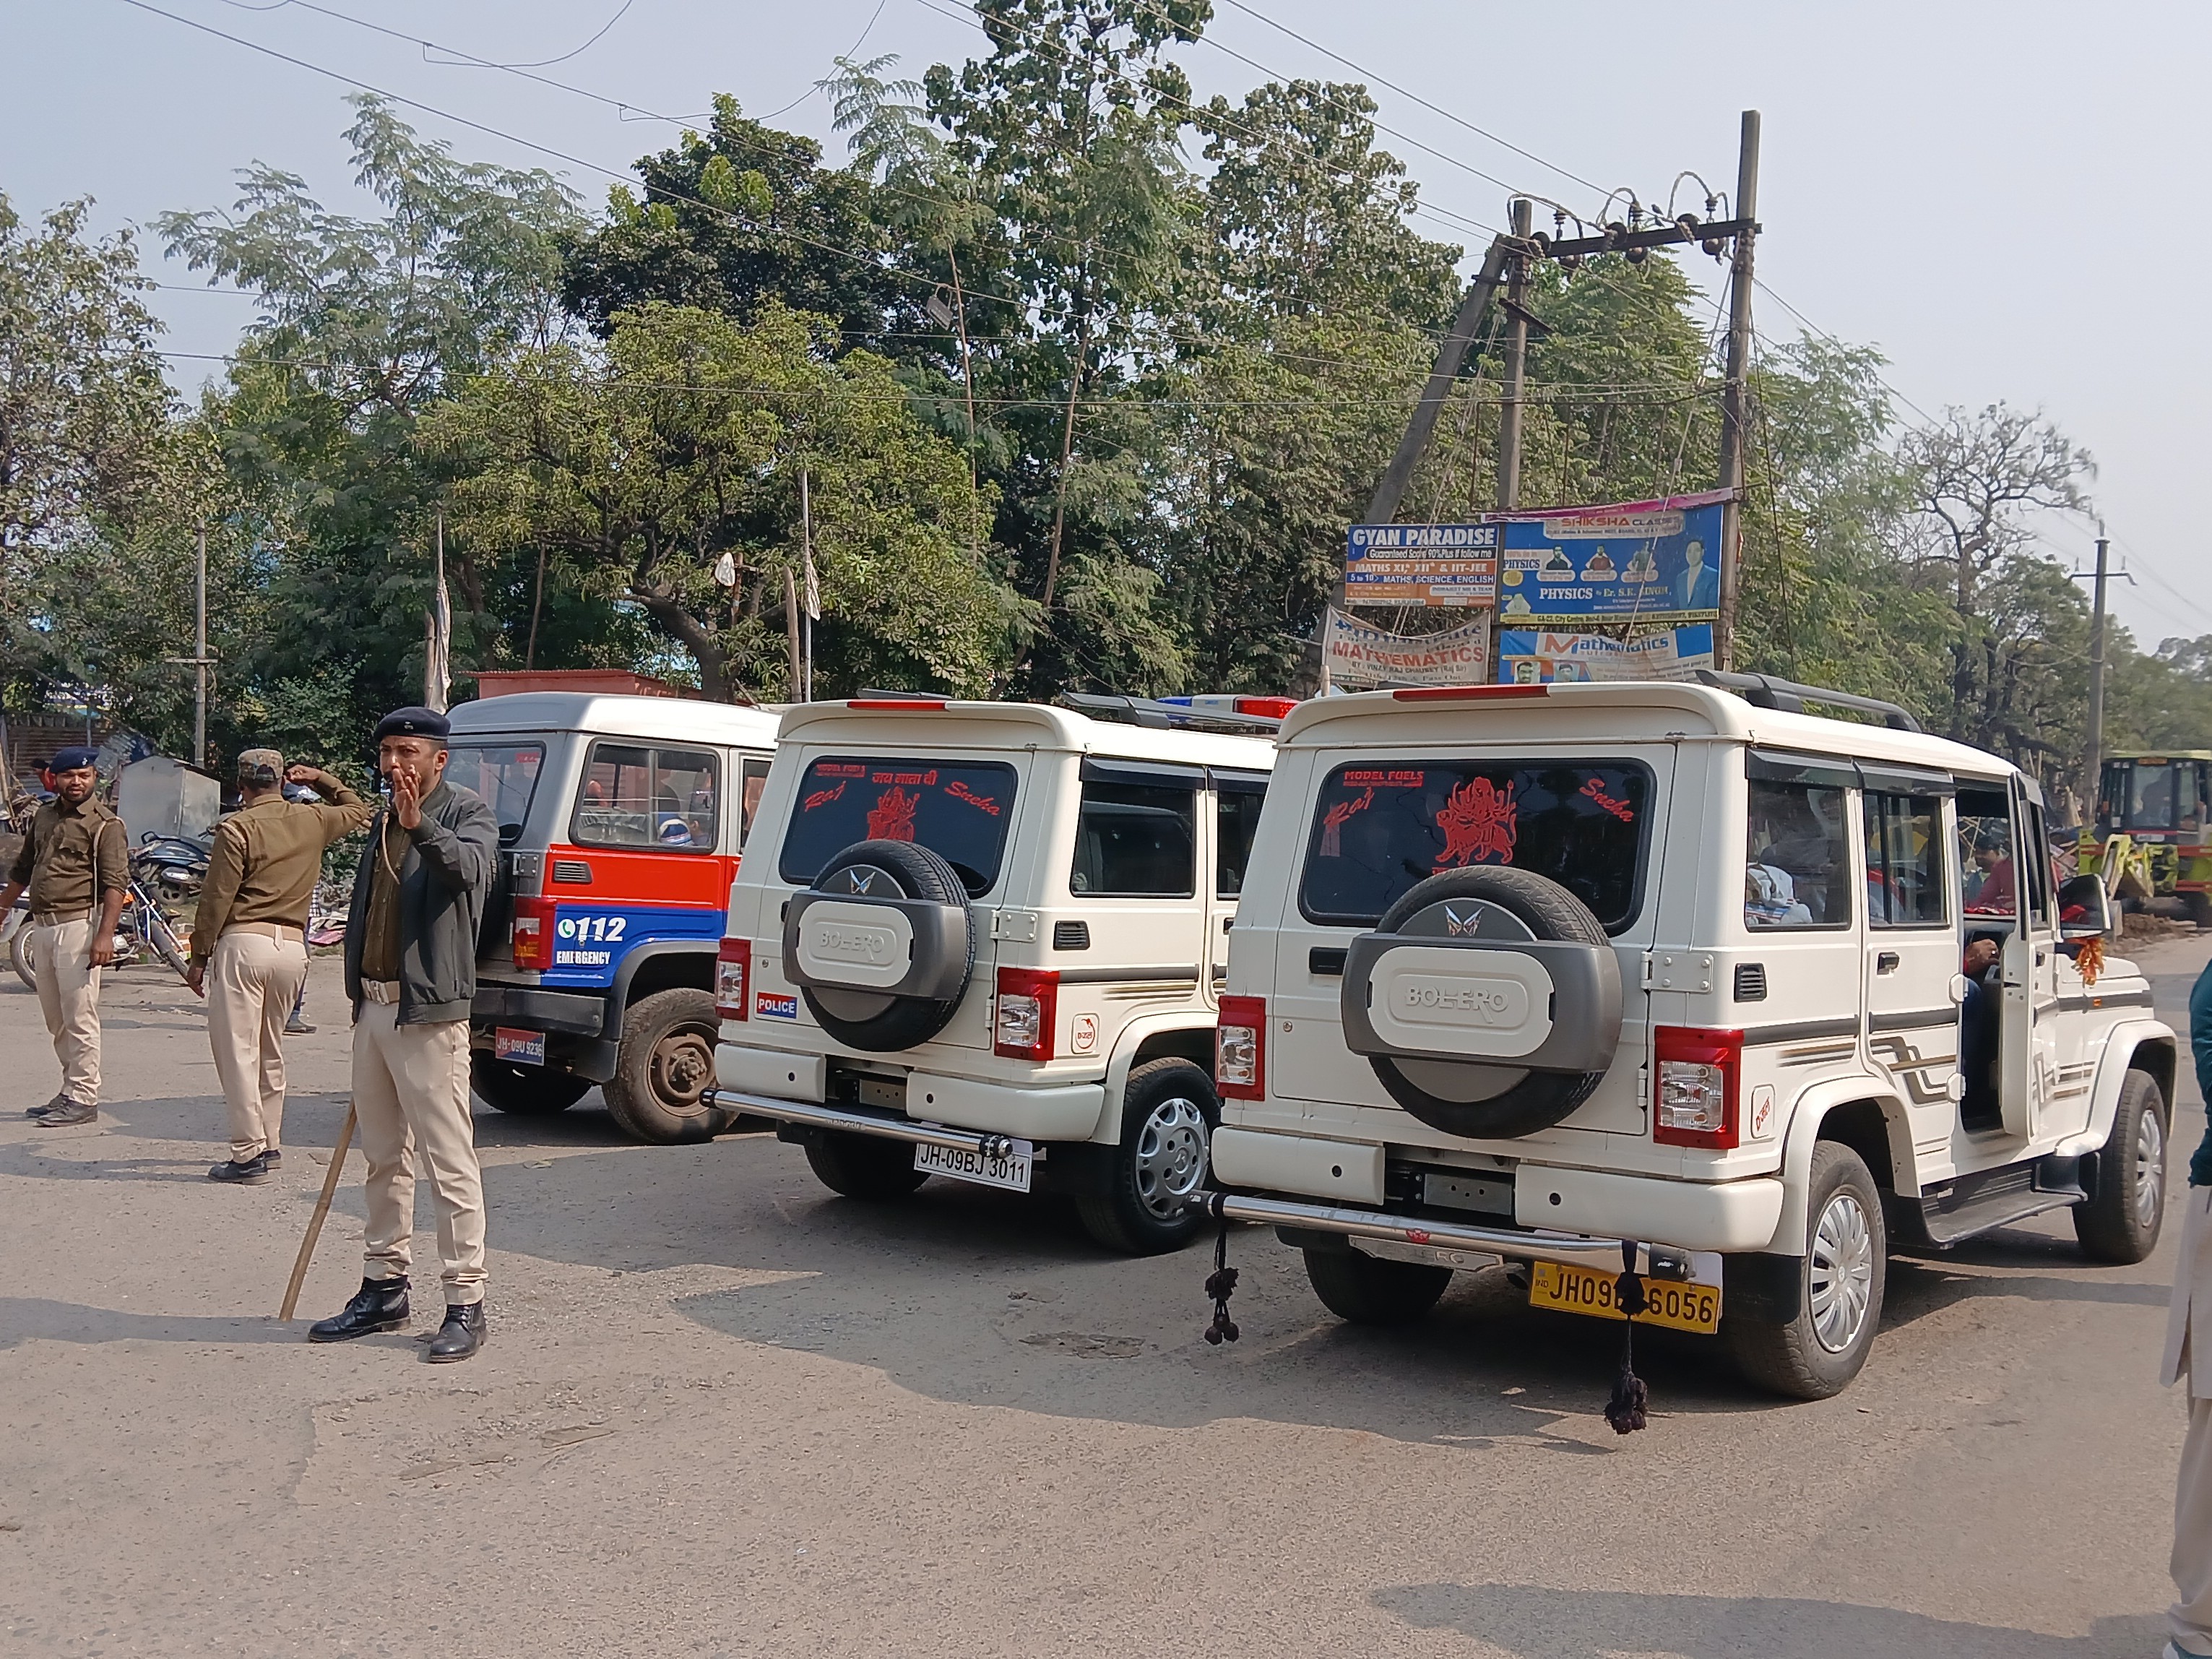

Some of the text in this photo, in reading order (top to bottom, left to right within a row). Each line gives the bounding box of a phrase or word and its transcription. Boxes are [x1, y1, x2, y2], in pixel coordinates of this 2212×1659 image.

[1561, 517, 1630, 527] SHIKSHA
[1352, 528, 1495, 546] GYAN PARADISE
[1370, 548, 1408, 559] Guaranteed
[1480, 548, 1492, 558] me
[1355, 564, 1391, 572] MATHS
[1439, 564, 1448, 572] &
[1451, 564, 1487, 572] IIT-JEE
[1503, 559, 1541, 569] PHYSICS
[1415, 575, 1455, 585] SCIENCE,
[1539, 587, 1594, 600] PHYSICS
[1331, 641, 1485, 667] MATHEMATICS
[872, 772, 894, 784] जय
[895, 773, 923, 785] माता
[1344, 771, 1425, 780] MODEL FUELS
[576, 917, 627, 941] 112
[819, 929, 885, 962] BOLERO
[556, 950, 611, 965] EMERGENCY
[758, 998, 795, 1014] POLICE
[1405, 984, 1509, 1024] BOLERO
[920, 1144, 1024, 1183] JH-09BJ 3011
[1535, 1278, 1550, 1288] IND
